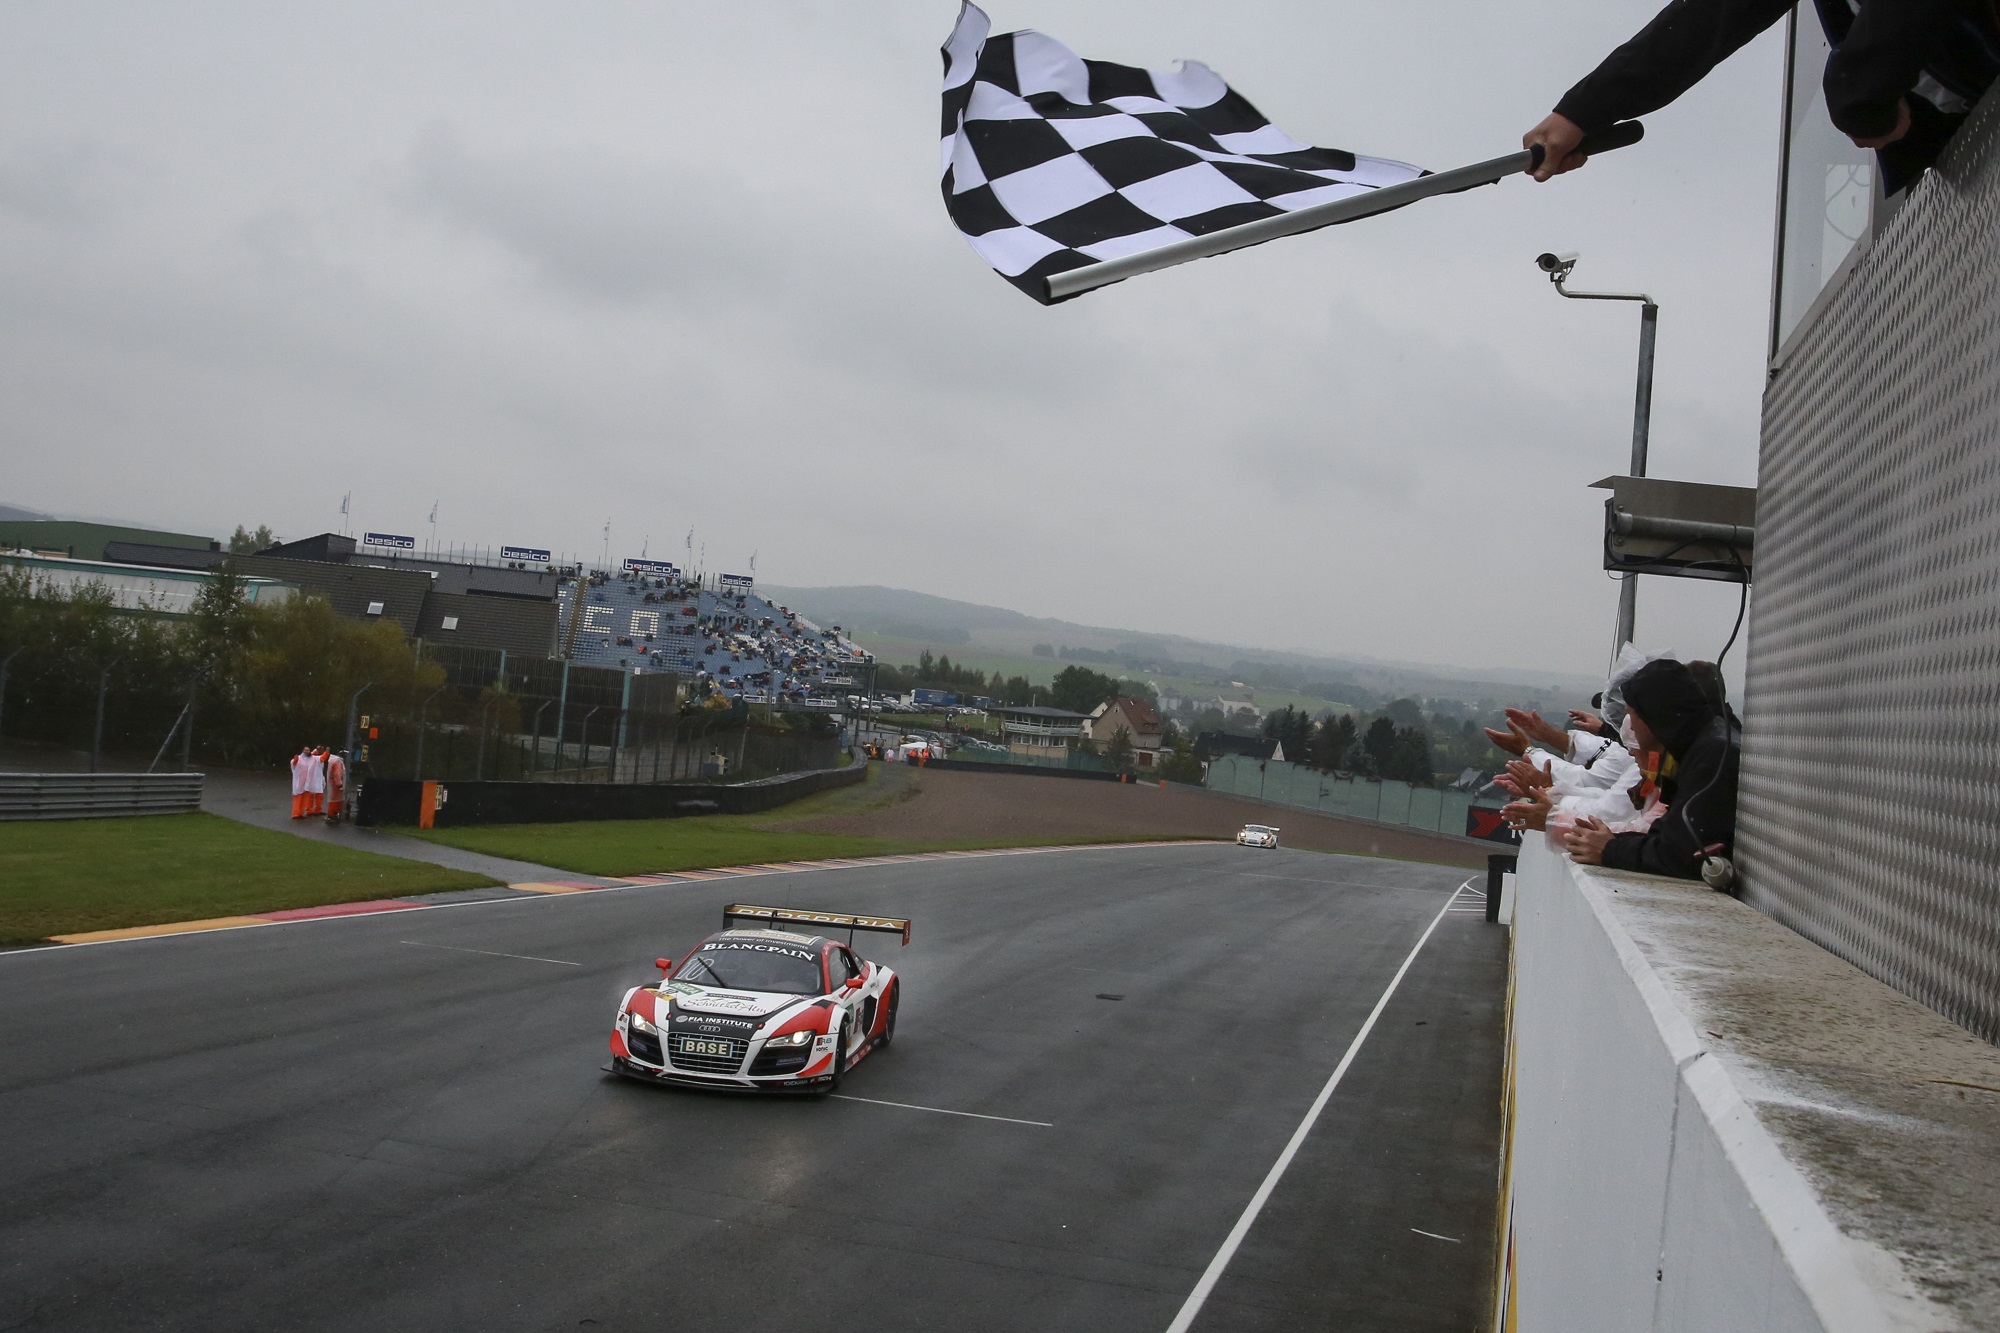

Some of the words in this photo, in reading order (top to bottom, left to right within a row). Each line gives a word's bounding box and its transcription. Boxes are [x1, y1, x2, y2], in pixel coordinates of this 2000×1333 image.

[365, 532, 413, 548] besico
[502, 545, 549, 561] besico
[625, 558, 671, 573] besico
[721, 573, 752, 587] besico
[701, 943, 816, 961] BLANCPAIN
[674, 957, 715, 980] 10
[705, 1017, 754, 1029] INSTITUTE
[685, 1040, 728, 1055] BASE
